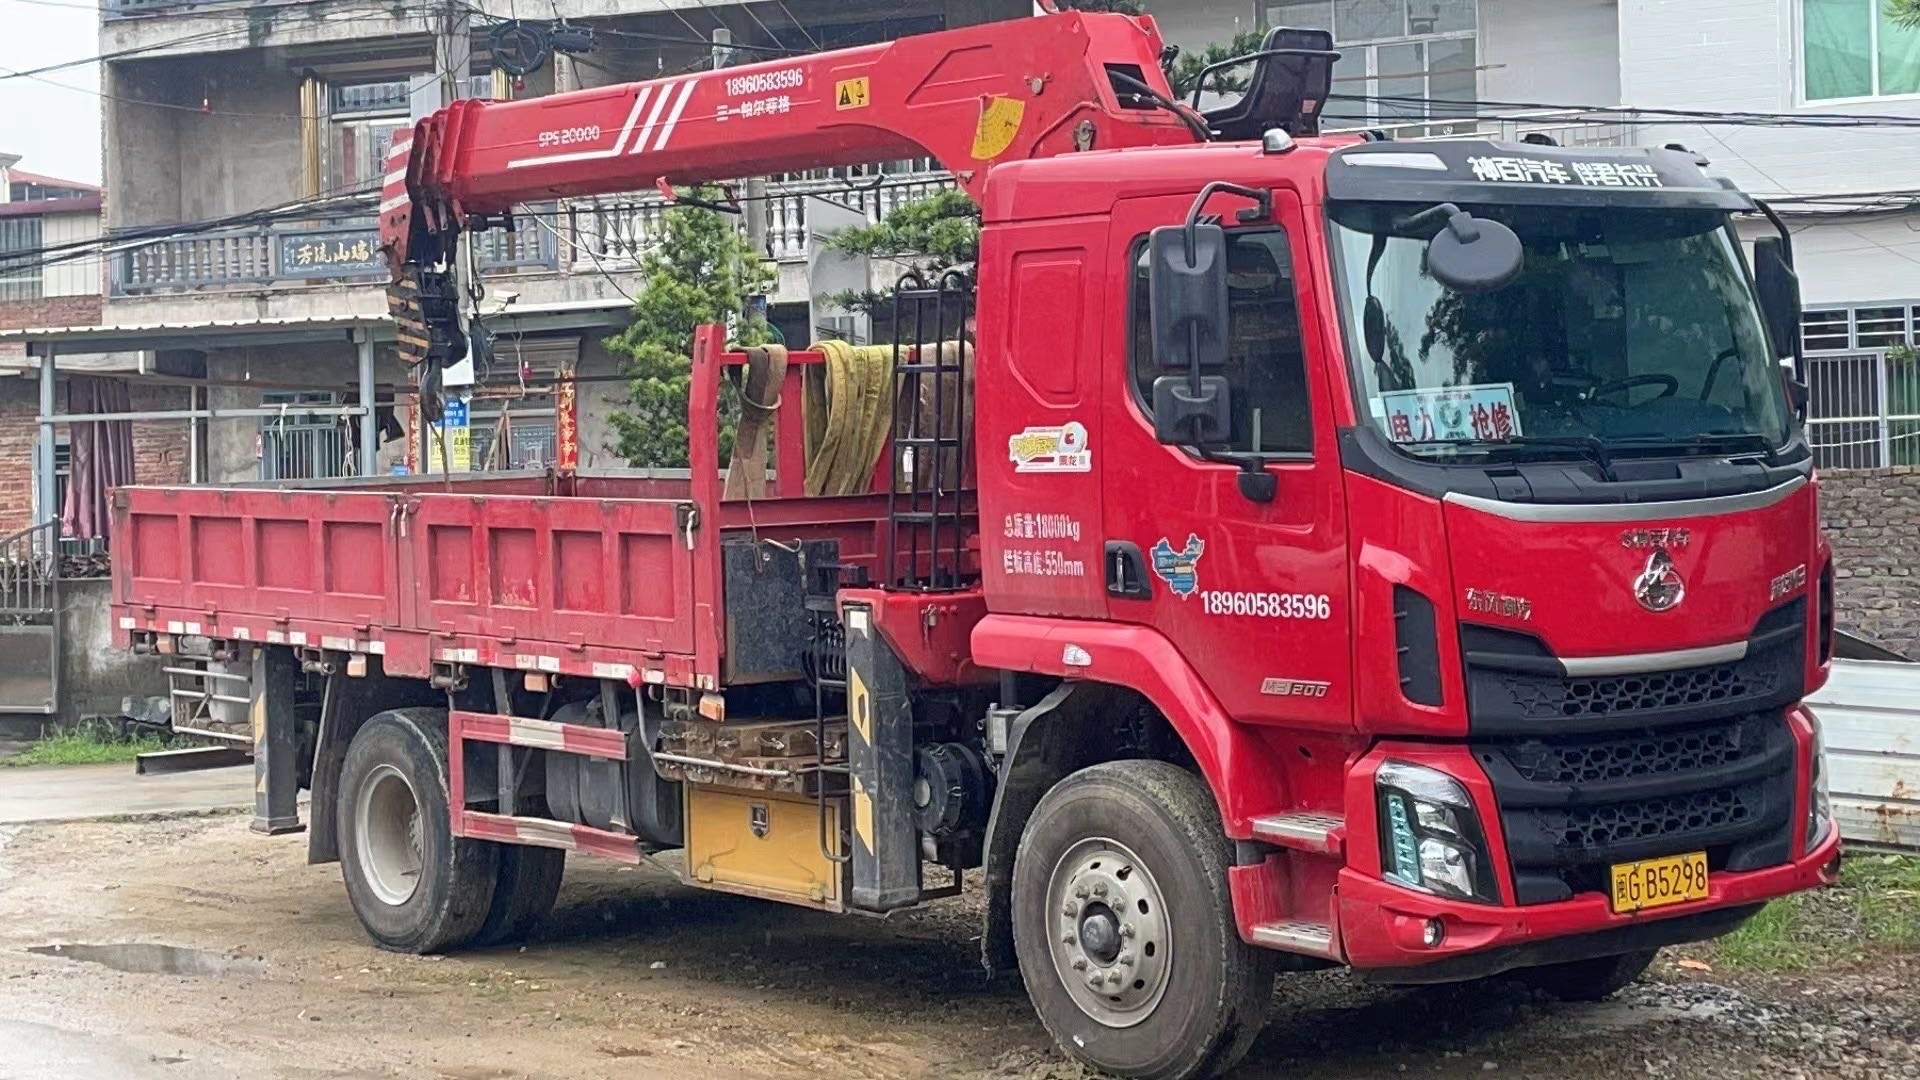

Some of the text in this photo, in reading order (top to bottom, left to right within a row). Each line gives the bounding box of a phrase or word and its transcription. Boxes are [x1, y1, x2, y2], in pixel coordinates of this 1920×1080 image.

[725, 68, 803, 97] 18960583596
[538, 125, 600, 147] SPS 20000
[1467, 156, 1664, 188] 神百汽车 伴君长兴
[1391, 401, 1513, 442] 电力 抢修
[1200, 590, 1331, 620] 18960583596
[1291, 683, 1328, 697] 200
